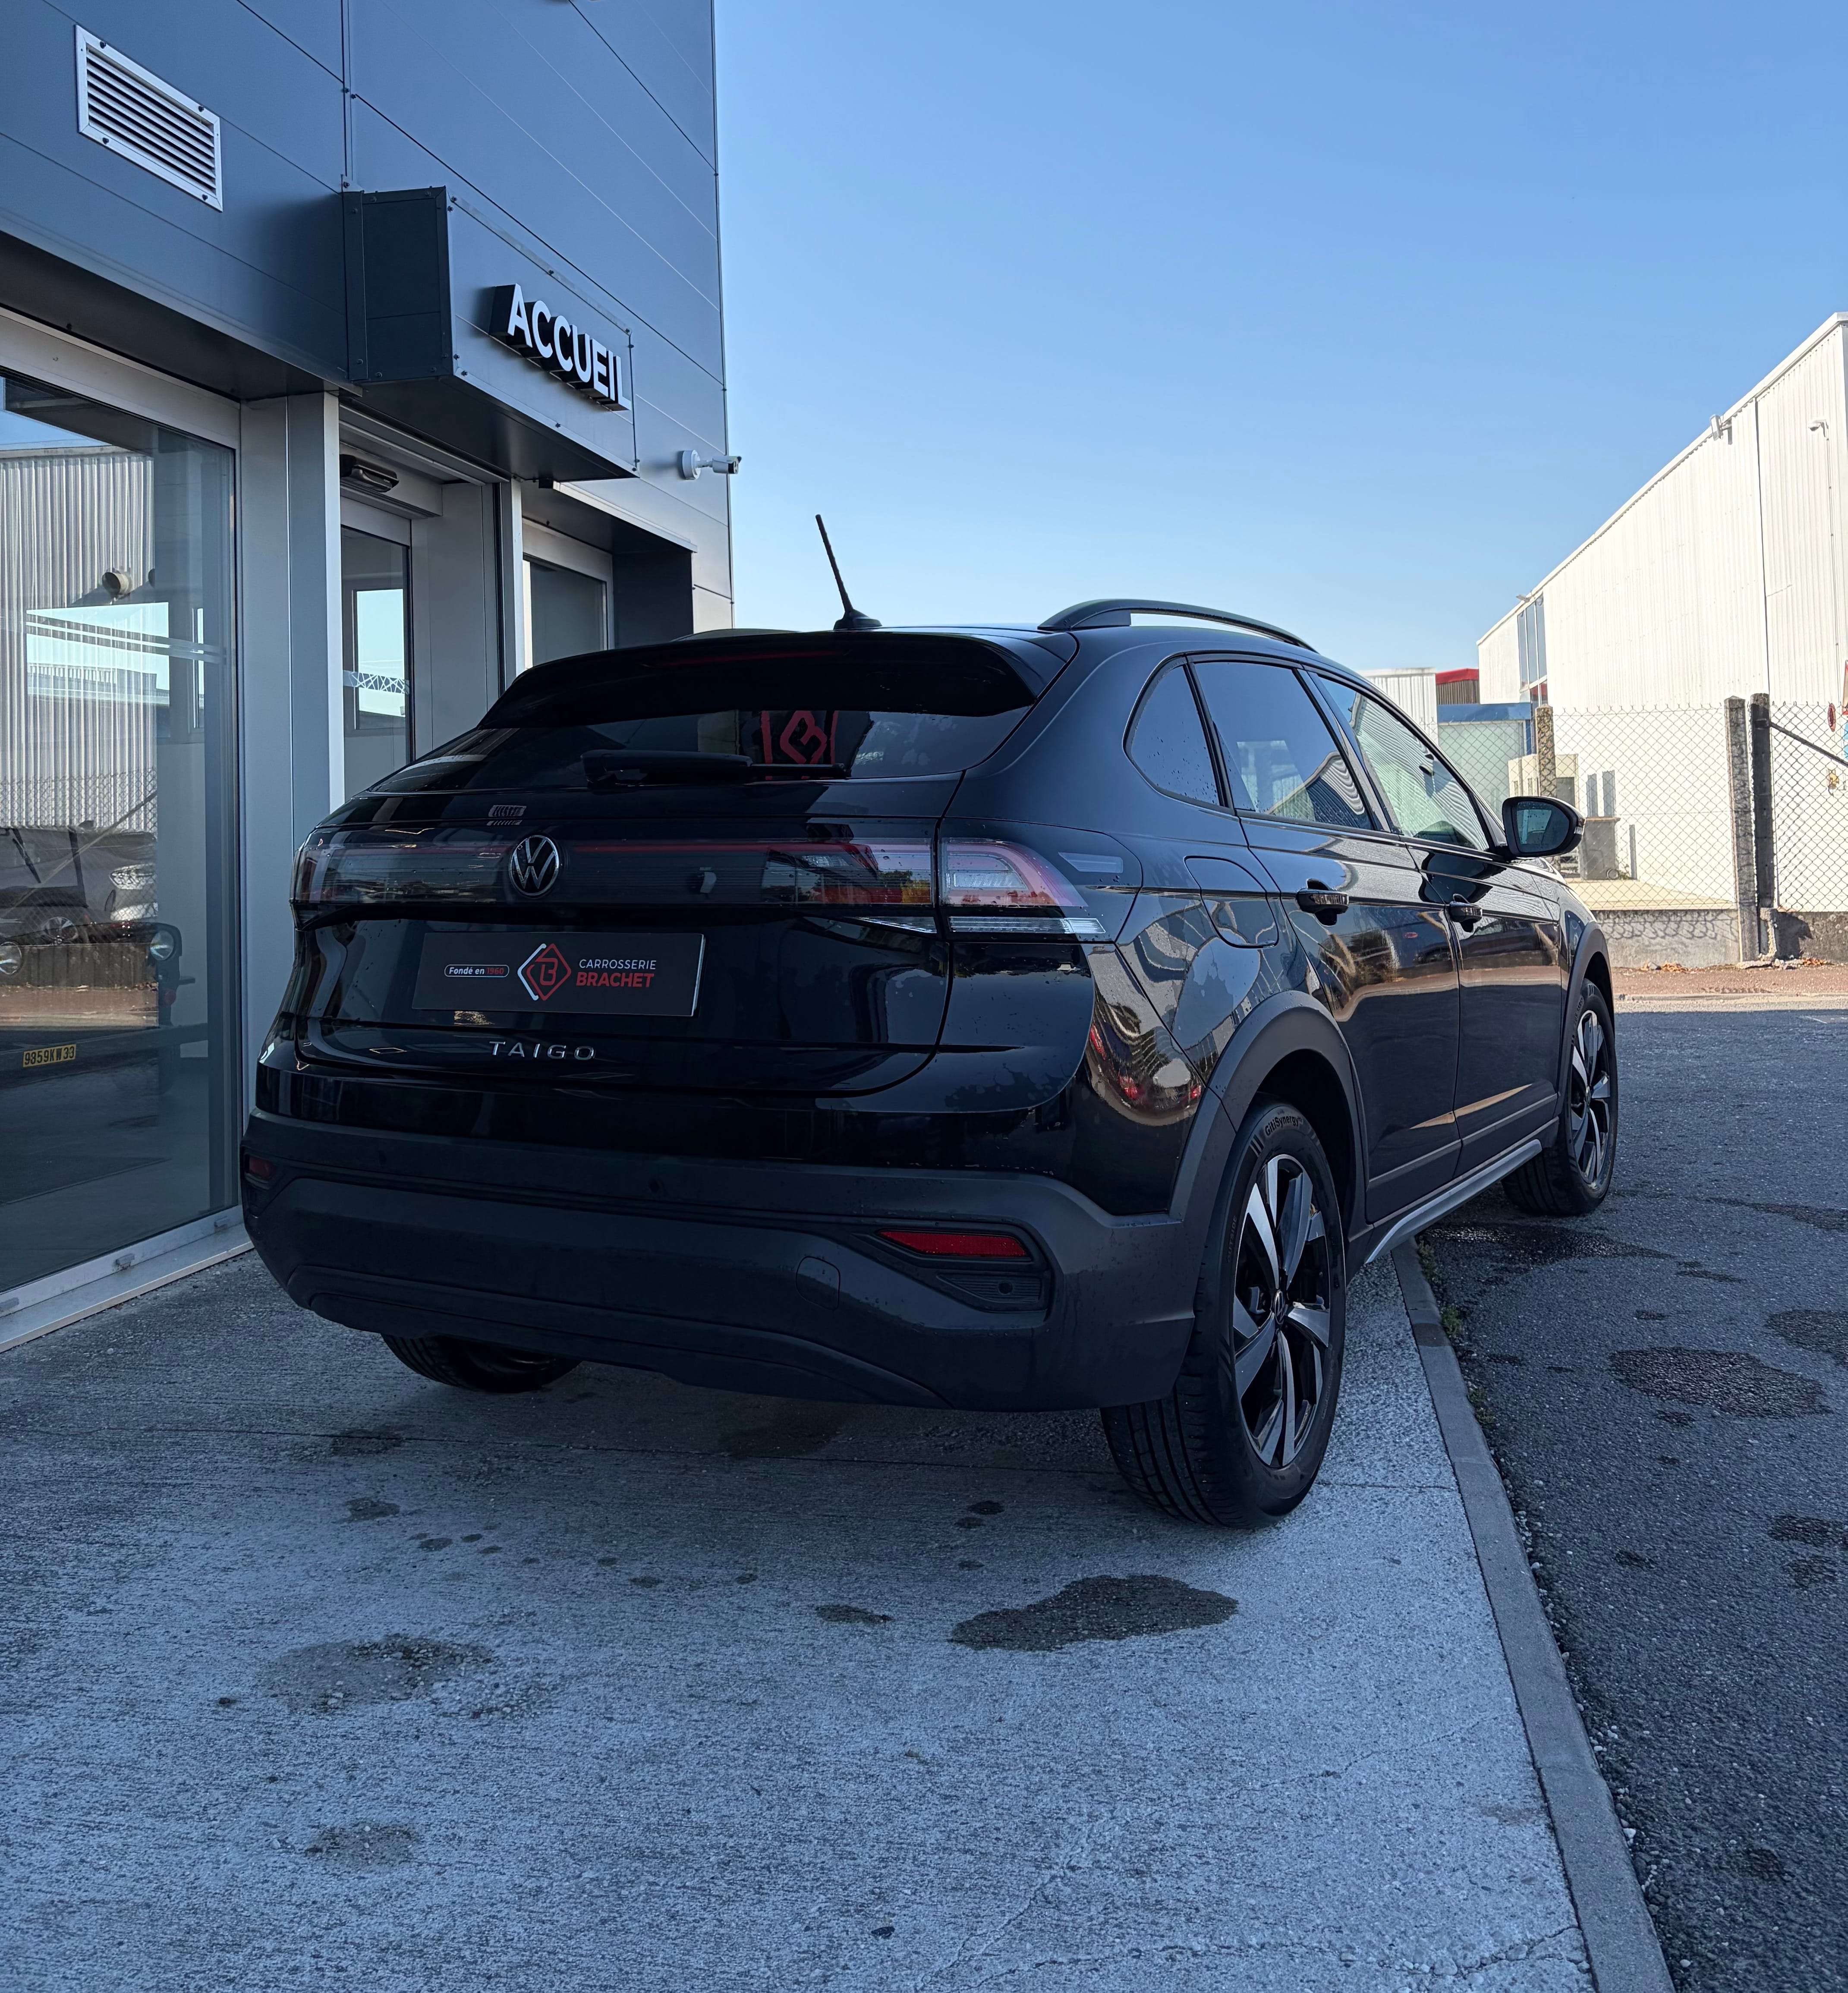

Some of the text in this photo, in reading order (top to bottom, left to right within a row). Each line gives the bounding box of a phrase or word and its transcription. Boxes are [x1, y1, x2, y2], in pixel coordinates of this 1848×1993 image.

[507, 283, 632, 411] ACCUEIL
[579, 959, 657, 970] CARROSSERIE
[576, 972, 655, 987] BRACHET
[489, 1041, 596, 1061] TAIGO
